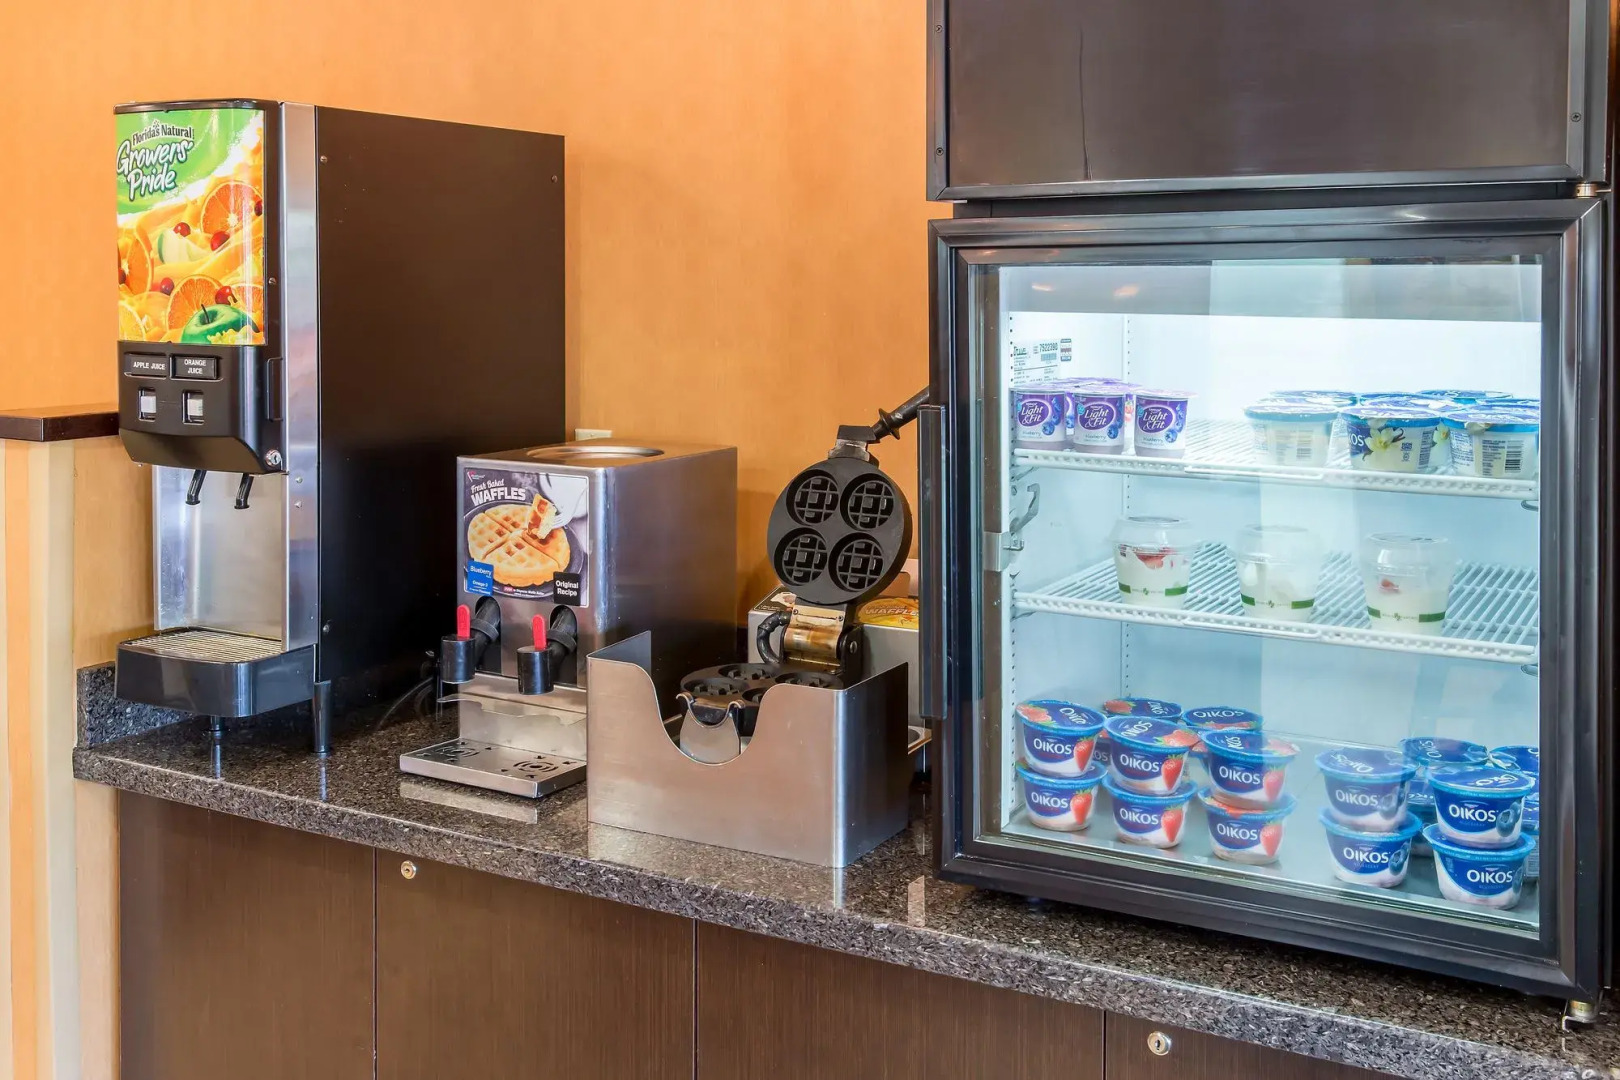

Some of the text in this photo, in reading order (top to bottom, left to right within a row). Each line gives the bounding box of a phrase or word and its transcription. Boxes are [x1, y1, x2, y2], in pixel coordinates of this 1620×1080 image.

[127, 162, 177, 202] Pride
[133, 361, 166, 371] APPLE JUICE
[1021, 405, 1044, 416] Light
[1084, 408, 1109, 419] Light
[1143, 411, 1168, 422] Light
[470, 487, 526, 506] WAFFLES
[470, 565, 492, 577] Blueberry
[555, 580, 579, 589] Original
[557, 588, 577, 597] Recipe
[865, 608, 919, 616] WAFFLE
[1193, 710, 1244, 718] OIKOS
[1033, 738, 1072, 755] OIKOS
[1119, 754, 1160, 773] OIKOS
[1218, 766, 1261, 785] OIKOS
[1031, 792, 1069, 809] OIKOS
[1335, 789, 1379, 807] OIKOS
[1119, 808, 1159, 825] OIKOS
[1448, 804, 1497, 823] OIKOS
[1216, 823, 1259, 841] OIKOS
[1343, 847, 1390, 864] OIKOS
[1466, 869, 1513, 884] OIKOS
